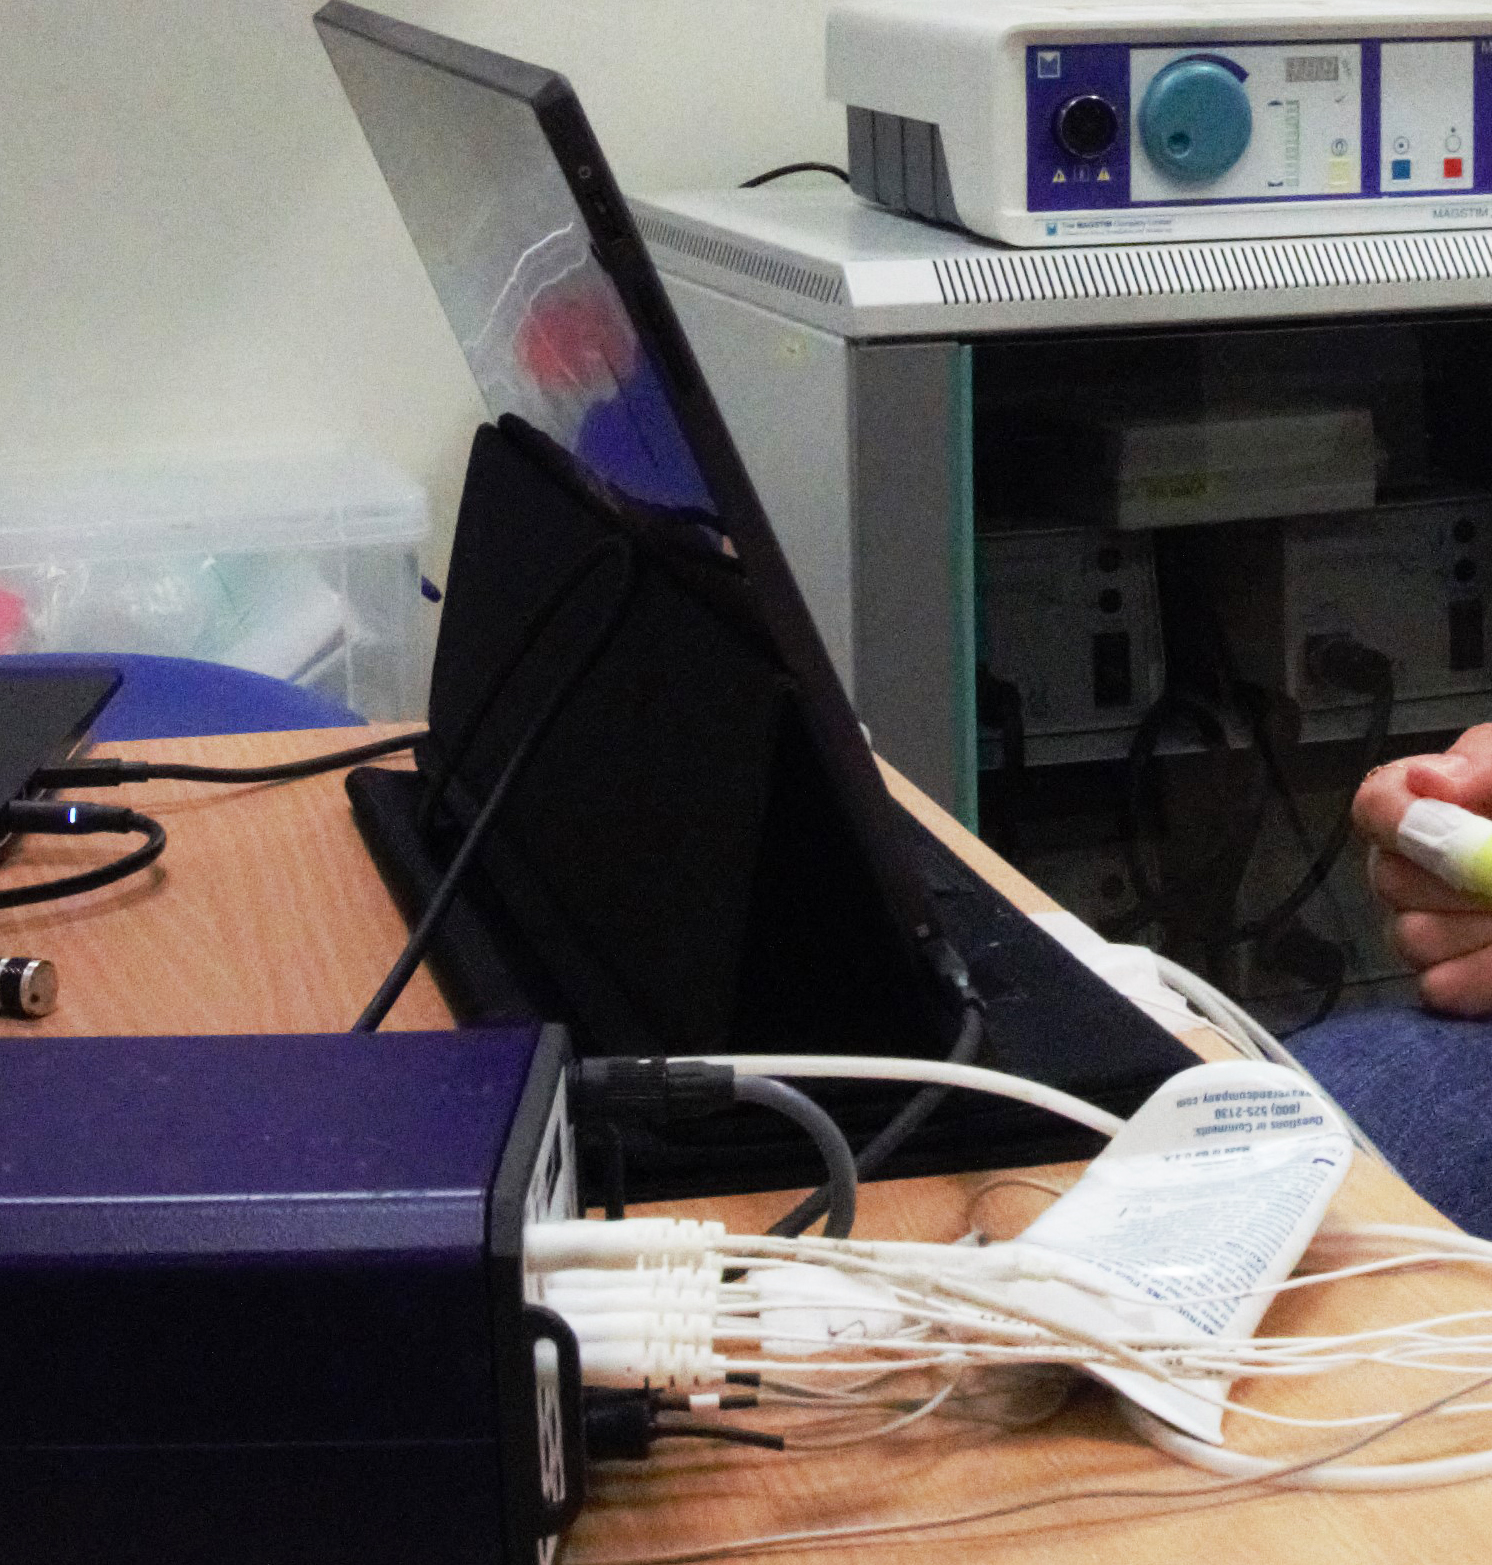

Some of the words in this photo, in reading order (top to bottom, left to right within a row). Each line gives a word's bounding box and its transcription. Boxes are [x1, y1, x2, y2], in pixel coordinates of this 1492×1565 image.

[1433, 207, 1488, 219] MAGSTIM
[1214, 1106, 1268, 1120] 525-2130
[1271, 1102, 1300, 1116] (800)
[1271, 1116, 1324, 1129] Questions
